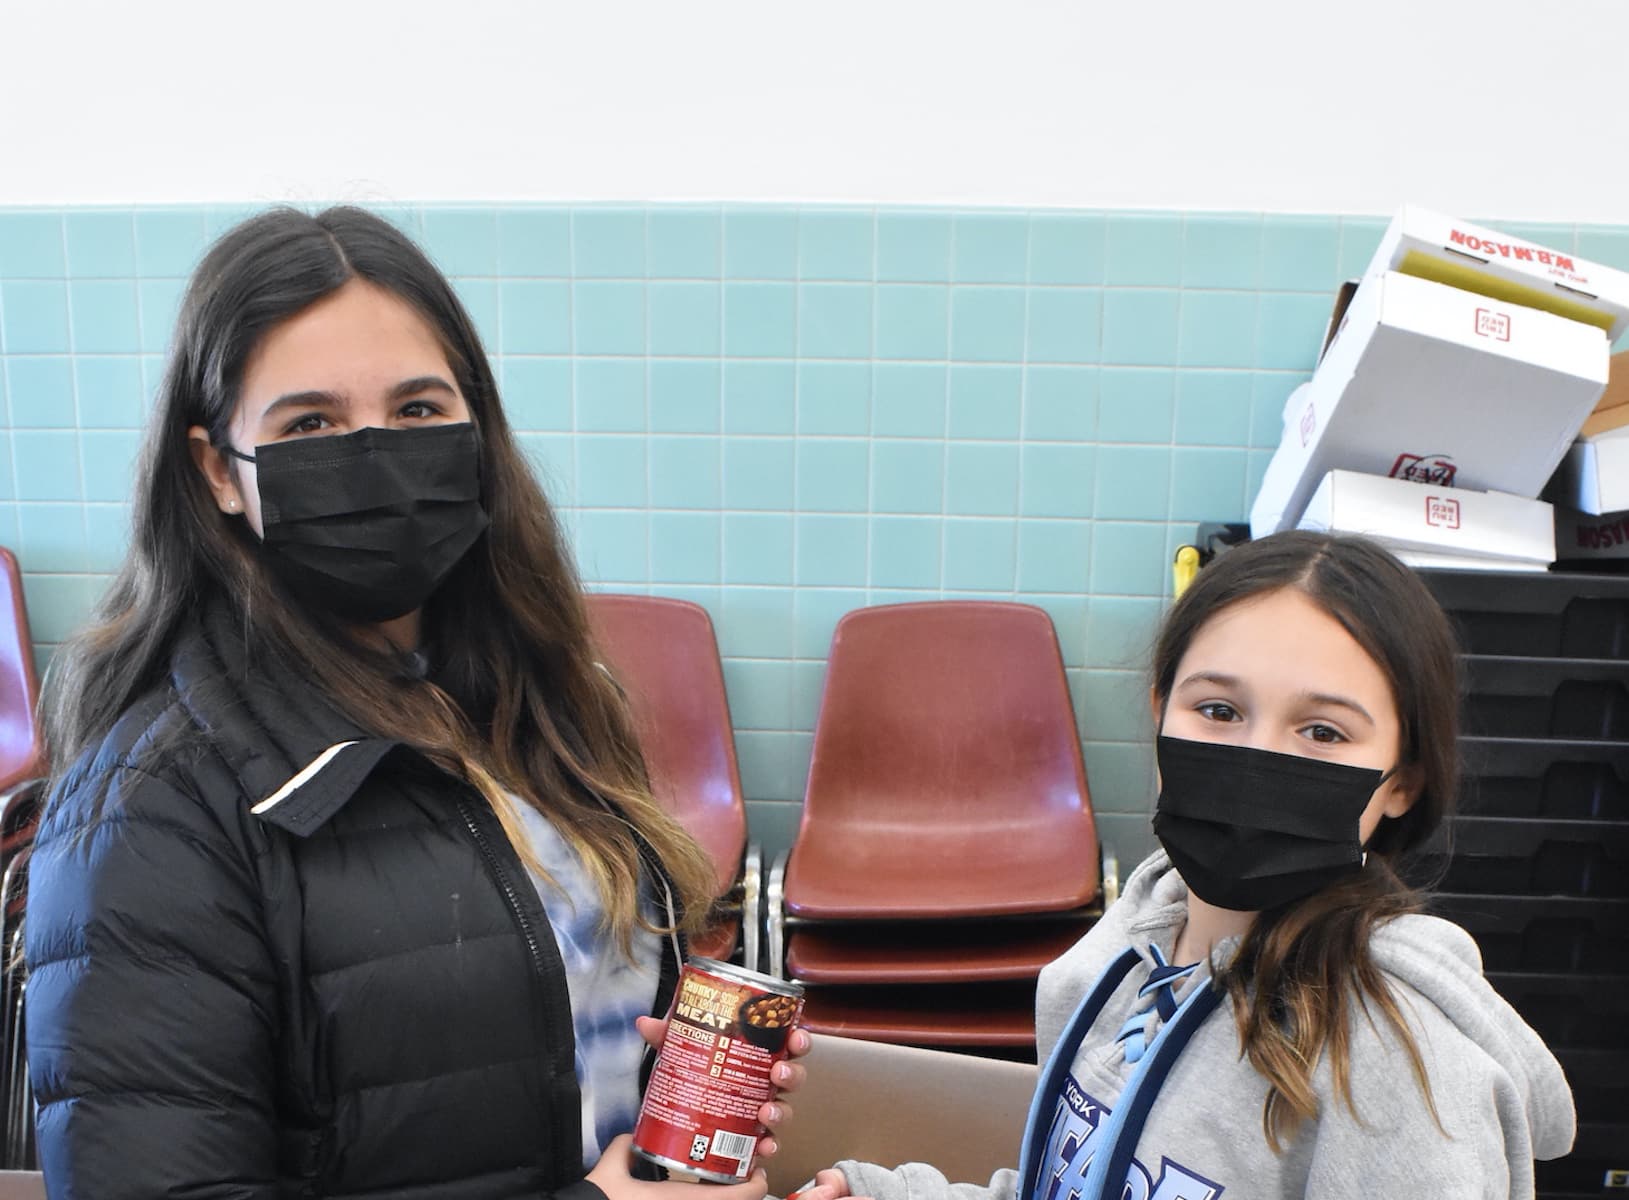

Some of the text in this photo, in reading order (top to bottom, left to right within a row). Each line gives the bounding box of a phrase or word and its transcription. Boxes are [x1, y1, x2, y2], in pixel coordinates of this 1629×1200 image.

[676, 1002, 732, 1030] MEAT
[669, 1021, 715, 1044] DIRECTIONS
[1065, 1081, 1096, 1118] YORK
